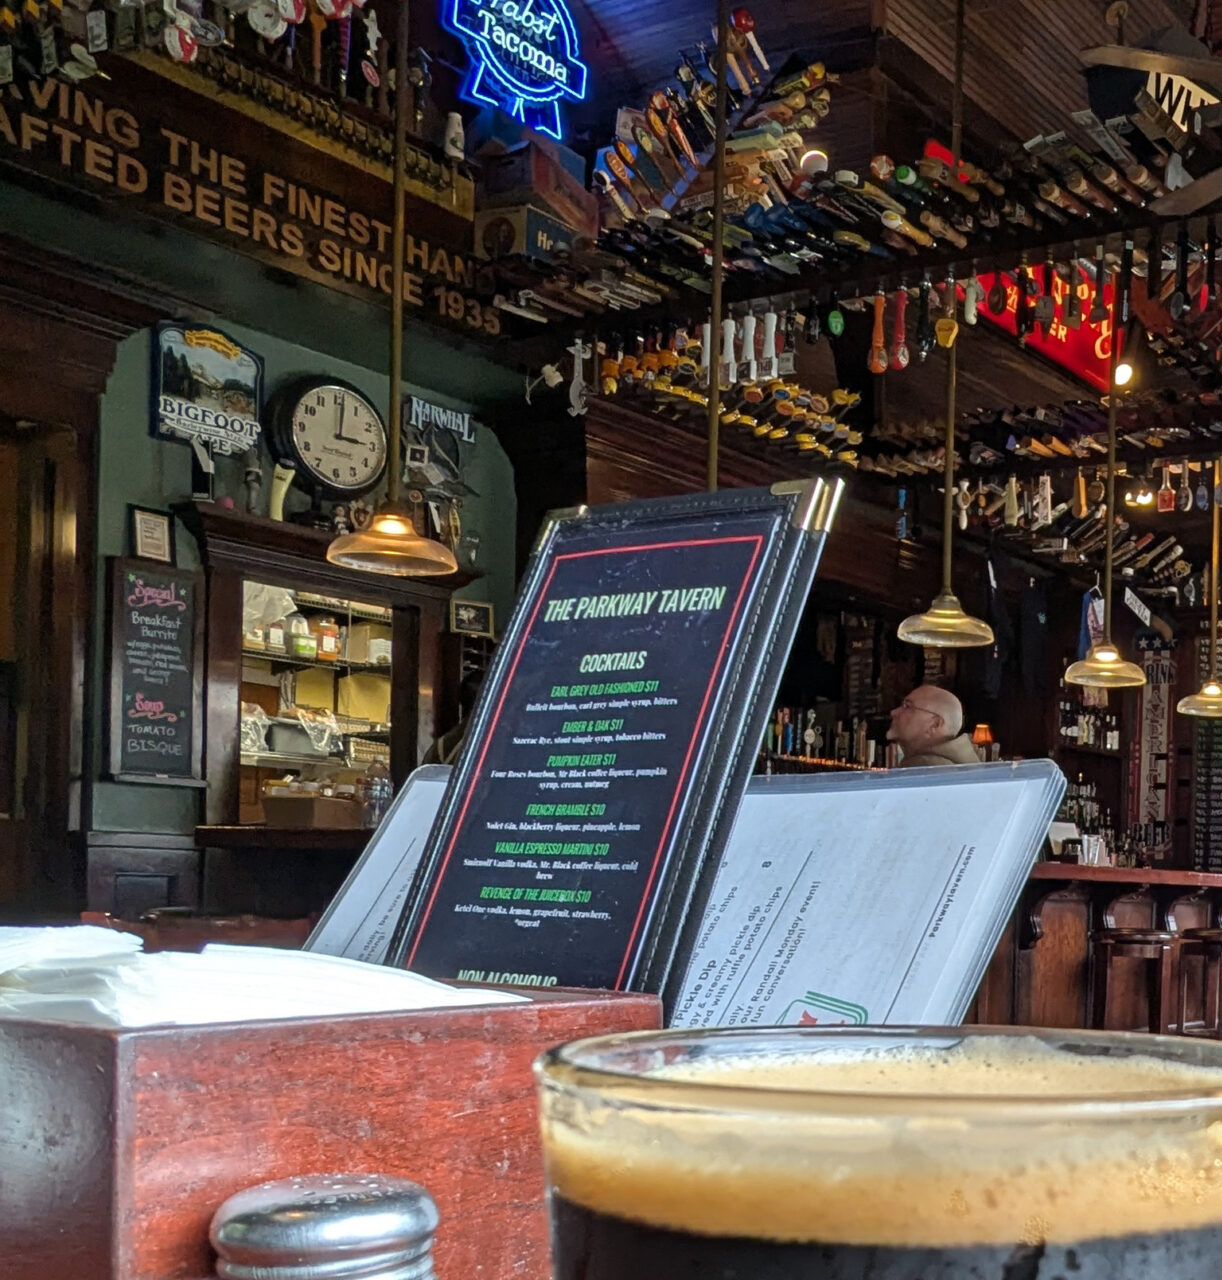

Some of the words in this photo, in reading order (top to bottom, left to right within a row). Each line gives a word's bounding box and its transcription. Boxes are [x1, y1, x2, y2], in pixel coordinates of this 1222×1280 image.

[478, 10, 567, 83] Tacoma
[9, 77, 140, 148] VING
[160, 128, 246, 194] THE
[263, 173, 392, 253] FINEST
[164, 172, 304, 257] BEERS
[318, 239, 423, 307] SINCE
[434, 286, 500, 336] 1935
[317, 395, 325, 407] 11
[304, 405, 316, 416] 10
[354, 406, 358, 416] 1
[162, 399, 259, 438] BIGFOOT
[410, 395, 476, 444] NARWHAL
[299, 421, 305, 432] 9
[365, 422, 372, 433] 2
[304, 441, 311, 452] 8
[369, 441, 376, 452] 3
[315, 457, 322, 468] 7
[361, 457, 368, 468] 4
[333, 468, 340, 478] 6
[543, 597, 574, 623] THE
[574, 591, 655, 620] PARKWAY
[658, 586, 727, 613] TAVERN
[132, 611, 182, 629] Breakfast
[141, 626, 177, 641] Burrito
[579, 651, 648, 674] COCKTAILS
[551, 684, 569, 697] EARL
[589, 682, 604, 696] OLD
[604, 681, 645, 695] FASHIONED
[135, 692, 164, 712] Soup
[549, 703, 578, 712] bourbon,
[579, 701, 592, 709] earl
[608, 700, 630, 709] simple
[653, 697, 678, 706] bitters
[127, 723, 175, 736] TOMATO
[562, 722, 586, 733] EMBER
[642, 732, 666, 740] bitters
[127, 738, 183, 755] BISQUE
[547, 755, 580, 767] PUMPKIN
[580, 754, 602, 767] EATER
[568, 769, 586, 777] Black
[636, 768, 667, 777] pumpkin
[526, 804, 555, 816] FRENCH
[556, 804, 589, 816] BRAMBLE
[519, 821, 553, 832] blackberry
[582, 823, 617, 832] pineapple,
[619, 823, 640, 831] lemon
[495, 842, 524, 855] VANILLA
[525, 843, 562, 855] ESPRESSO
[562, 843, 593, 855] MARTINI
[552, 860, 571, 869] Black
[480, 886, 512, 900] REVENGE
[513, 887, 524, 899] OF
[524, 888, 539, 901] THE
[539, 889, 575, 902] JUICEBOX
[509, 907, 531, 916] lemon,
[532, 908, 570, 918] grapefruit,
[572, 910, 612, 921] strawberry,
[698, 915, 720, 949] potato
[719, 886, 738, 913] chips
[705, 959, 732, 998] creamy
[730, 925, 750, 956] pickle
[748, 905, 761, 922] dip
[712, 984, 728, 1006] with
[728, 953, 745, 981] ruffle
[744, 916, 766, 950] potato
[764, 886, 782, 913] chips
[457, 970, 484, 982] NON
[741, 1005, 754, 1024] our
[751, 961, 778, 1001] Randall
[775, 916, 802, 958] Monday
[750, 1005, 765, 1023] fun
[764, 928, 807, 1001] conversation!
[675, 983, 702, 1021] Pickle
[699, 960, 717, 981] Dip
